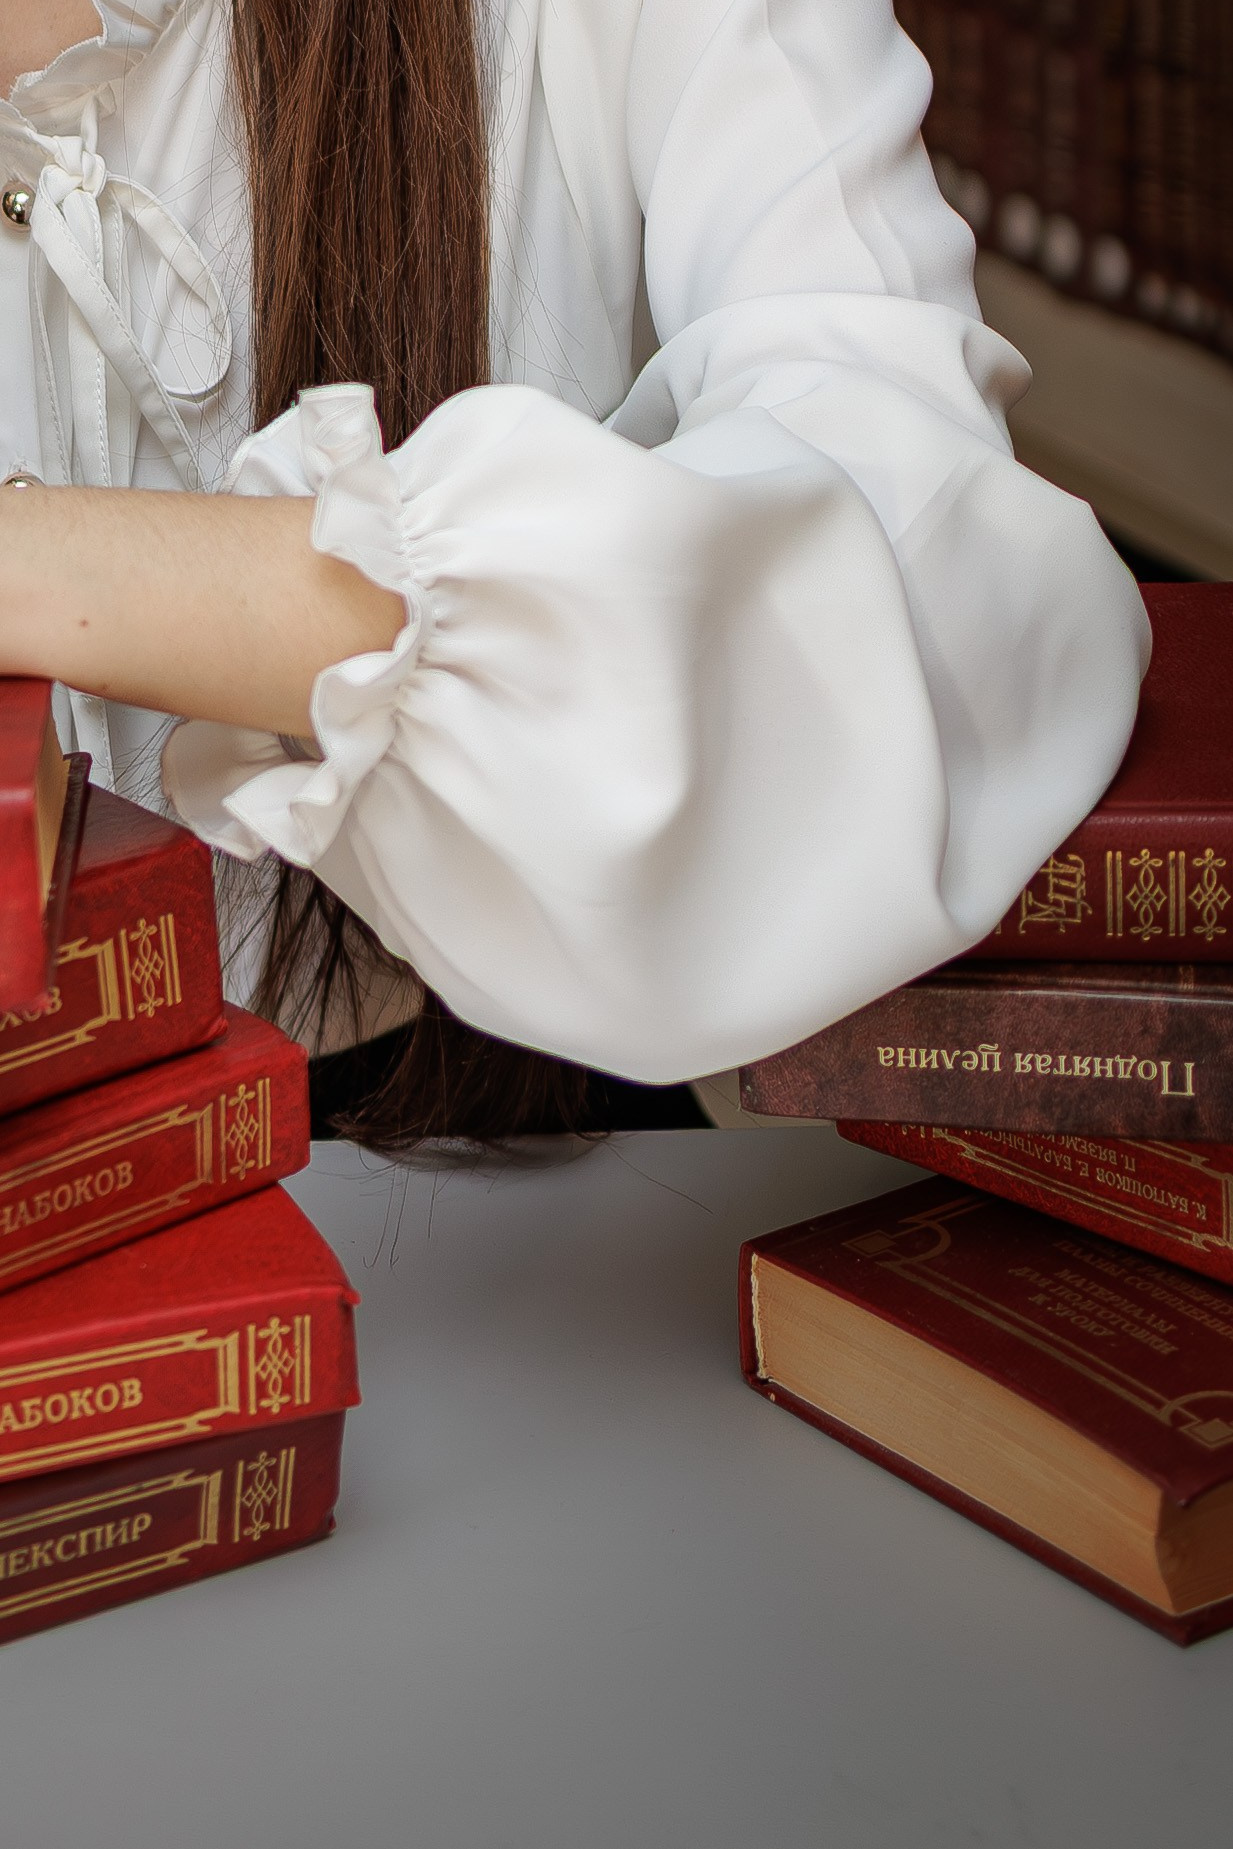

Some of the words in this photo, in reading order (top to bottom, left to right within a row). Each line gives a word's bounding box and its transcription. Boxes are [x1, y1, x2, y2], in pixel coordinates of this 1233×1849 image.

[877, 1043, 1002, 1073] целина
[1014, 1053, 1196, 1097] Поднятая
[1119, 1153, 1137, 1173] П.
[1096, 1168, 1190, 1215] БАТЮШКОВ
[1191, 1200, 1208, 1222] К.
[1049, 1285, 1180, 1356] ПОДГОТОВКИ
[1054, 1268, 1178, 1334] МАТЕРИАЛЫ
